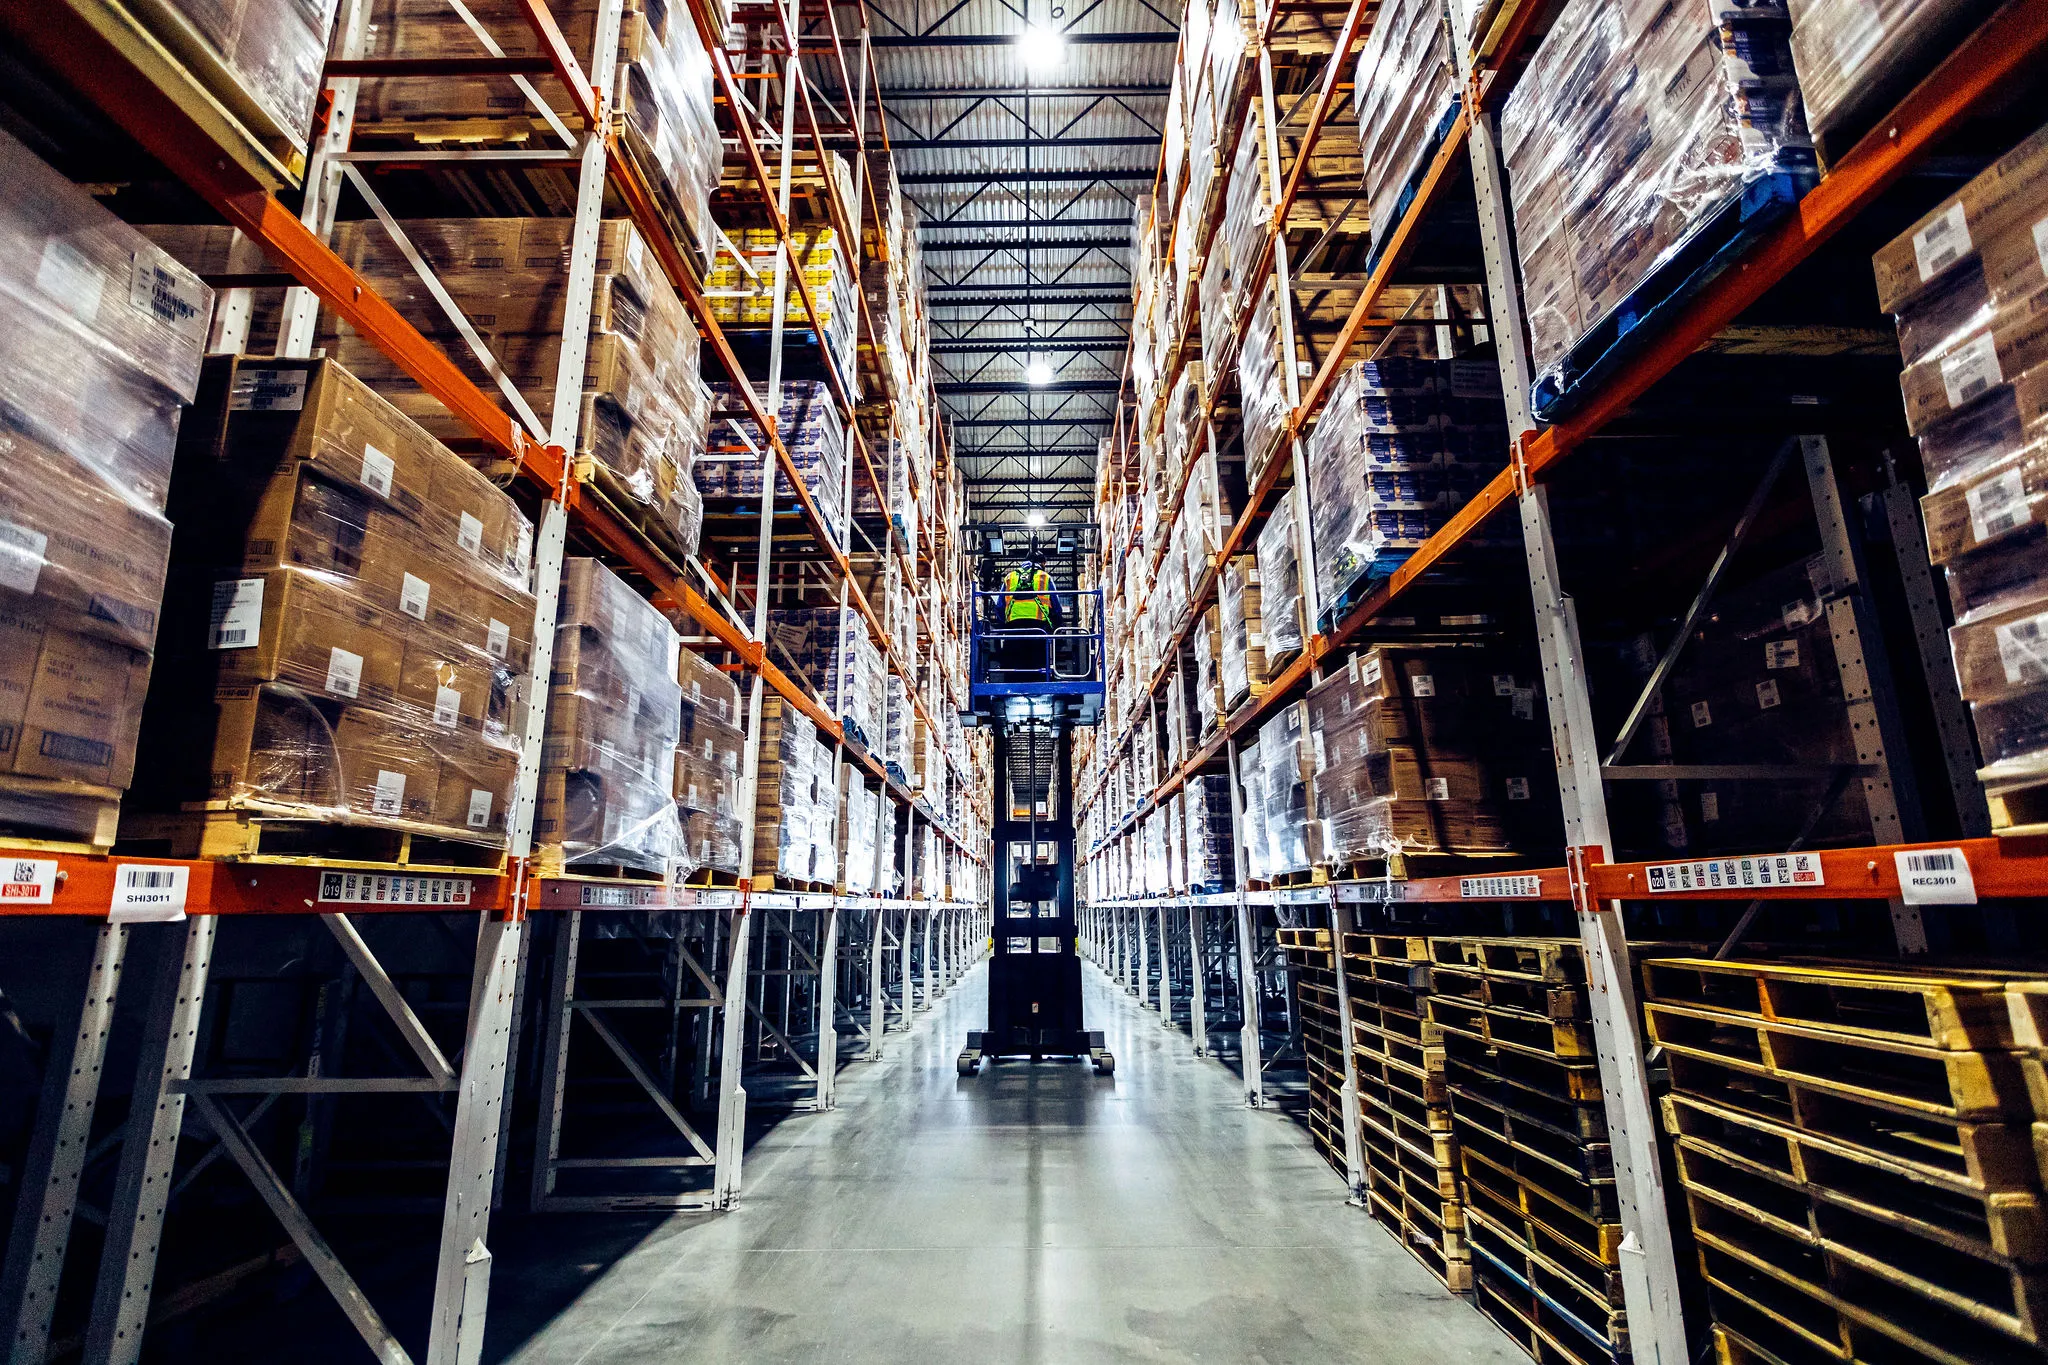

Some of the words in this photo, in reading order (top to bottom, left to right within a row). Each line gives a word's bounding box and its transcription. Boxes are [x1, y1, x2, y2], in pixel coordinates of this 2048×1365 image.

[1651, 877, 1665, 888] 020
[1761, 875, 1770, 883] 07
[1912, 877, 1956, 886] REC3010
[5, 885, 38, 897] SHI-3011
[324, 884, 340, 897] 019
[126, 894, 171, 903] SHI3011
